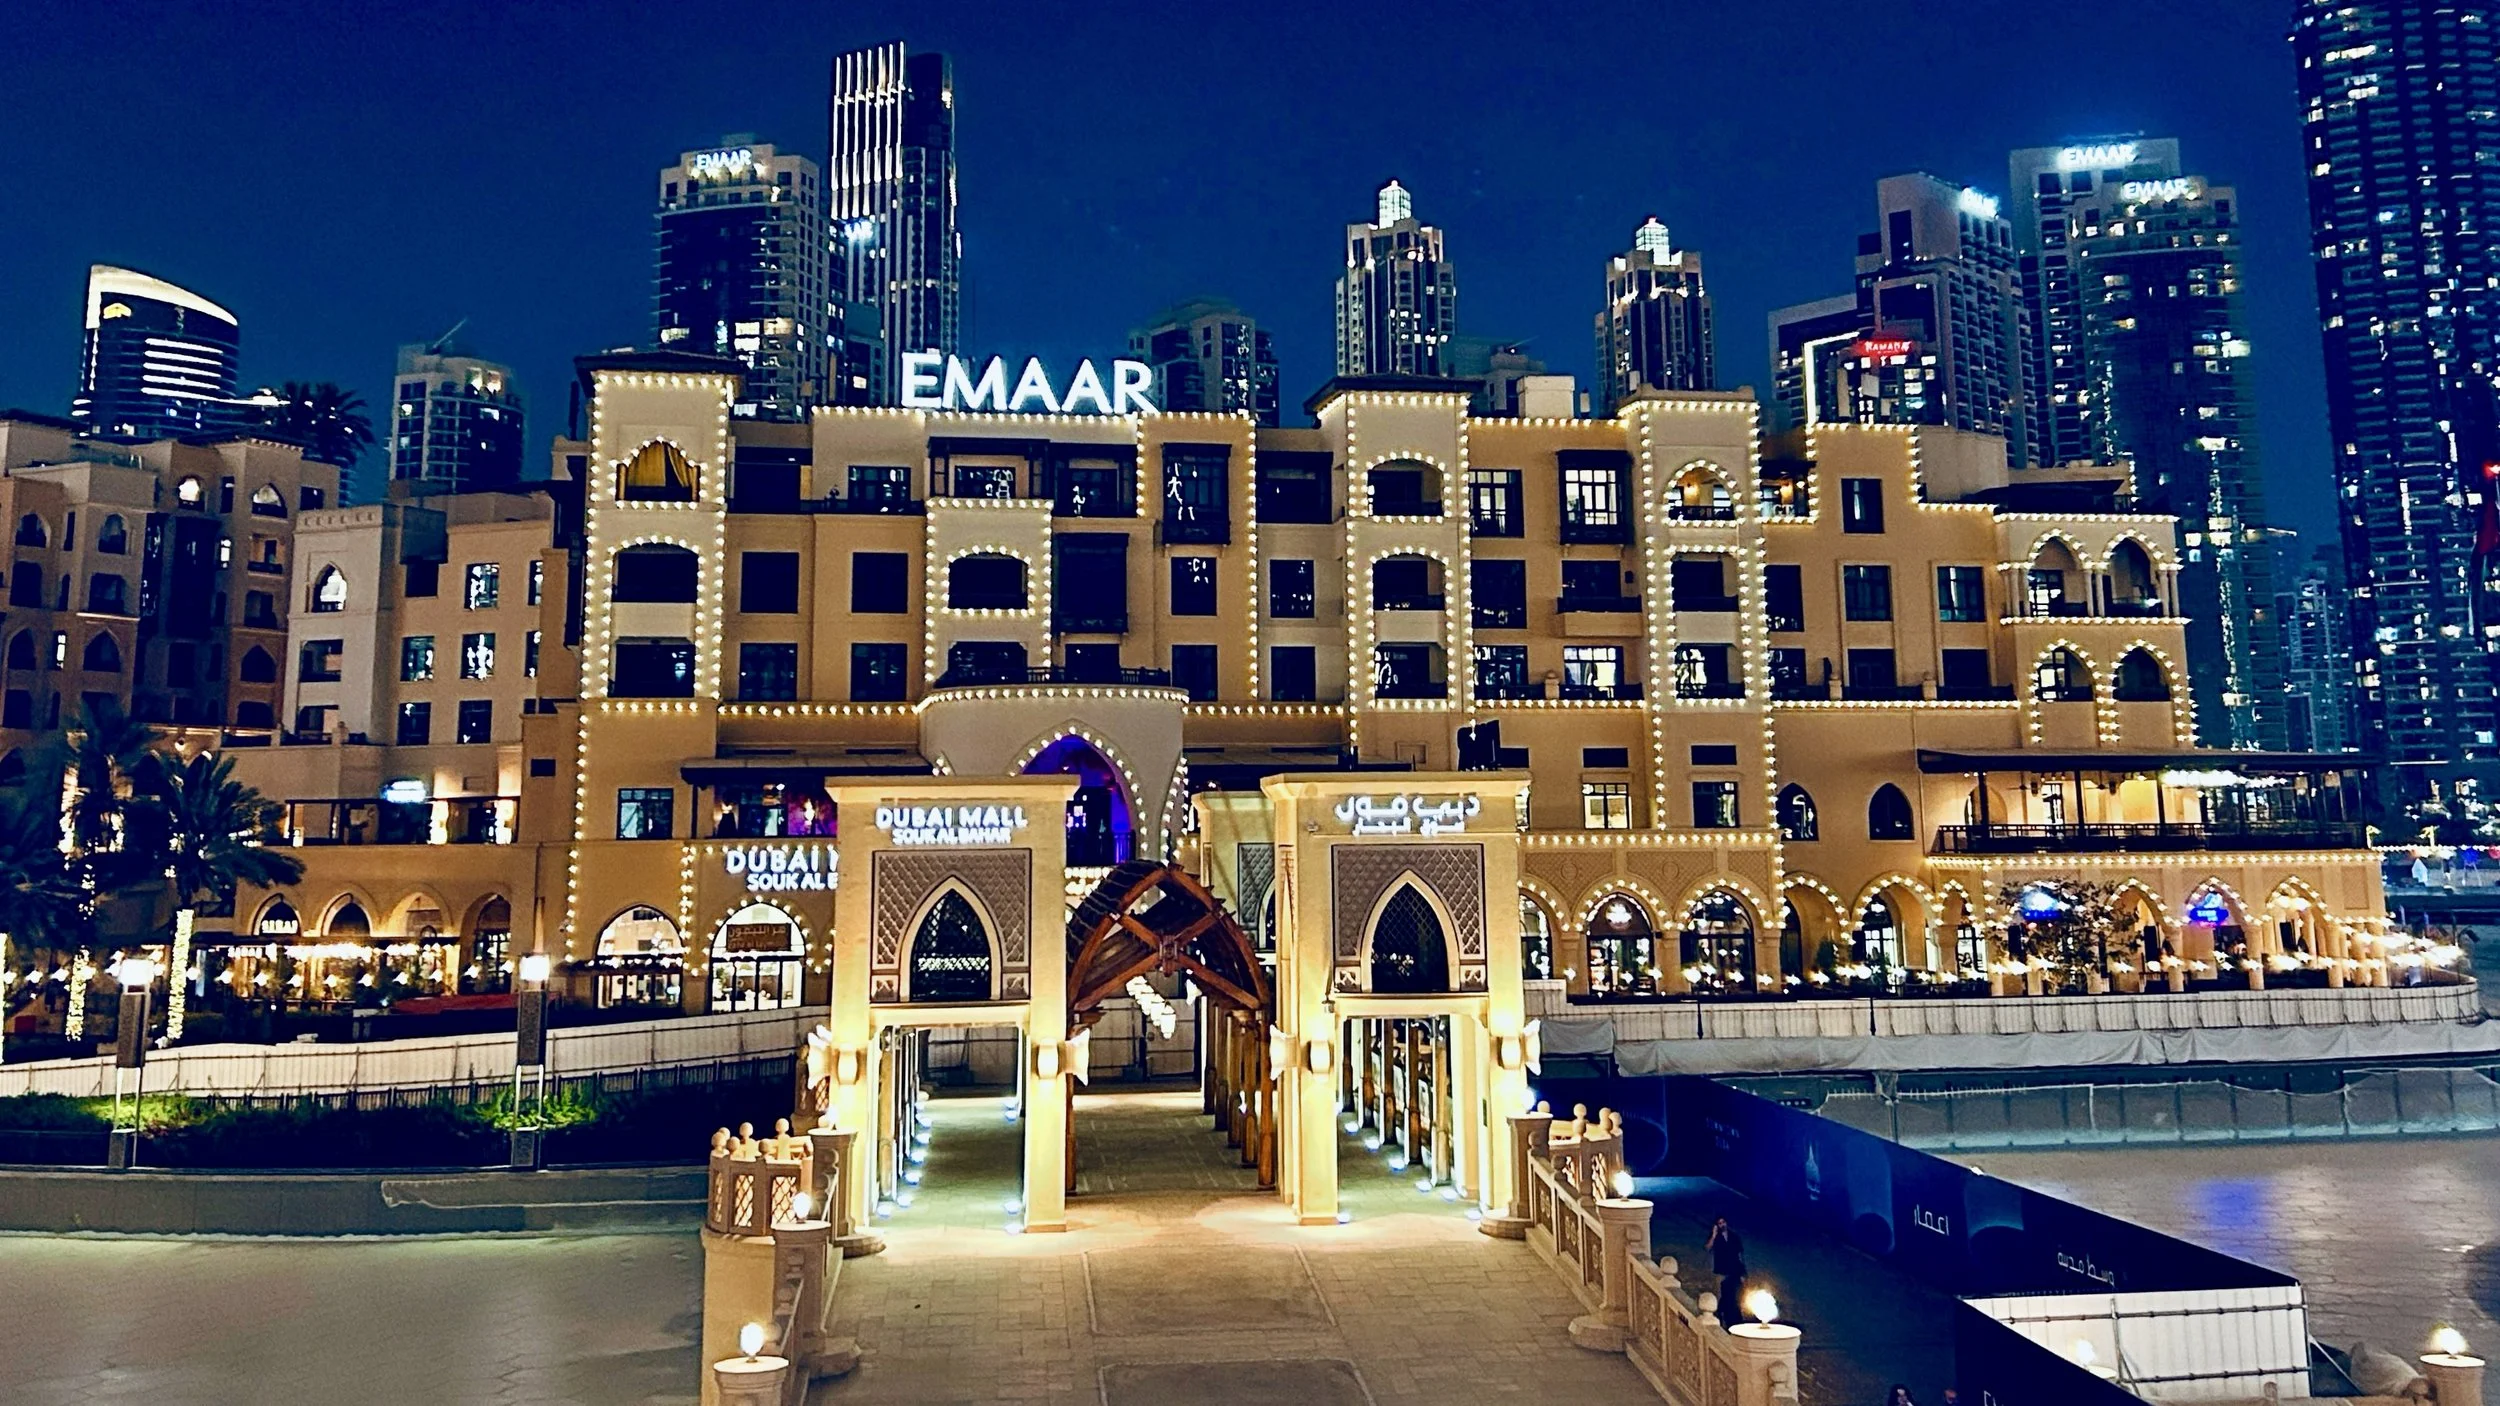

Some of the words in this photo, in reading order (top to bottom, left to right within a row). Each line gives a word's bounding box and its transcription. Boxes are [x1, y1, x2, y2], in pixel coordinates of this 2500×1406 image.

[696, 149, 752, 169] EMAAR
[2063, 144, 2137, 167] EMAAR
[2123, 178, 2189, 200] EMAAR
[901, 350, 1160, 415] EMAAR
[875, 806, 953, 830] DUBAI
[958, 806, 1028, 828] MALL
[1335, 796, 1408, 822] مول
[1413, 796, 1480, 821] دبي
[893, 828, 935, 846] SOUK
[935, 828, 958, 845] AL
[958, 827, 1012, 845] BAHAR
[726, 848, 819, 874] DUBAI
[747, 872, 799, 891] SOUK
[800, 872, 826, 890] AL
